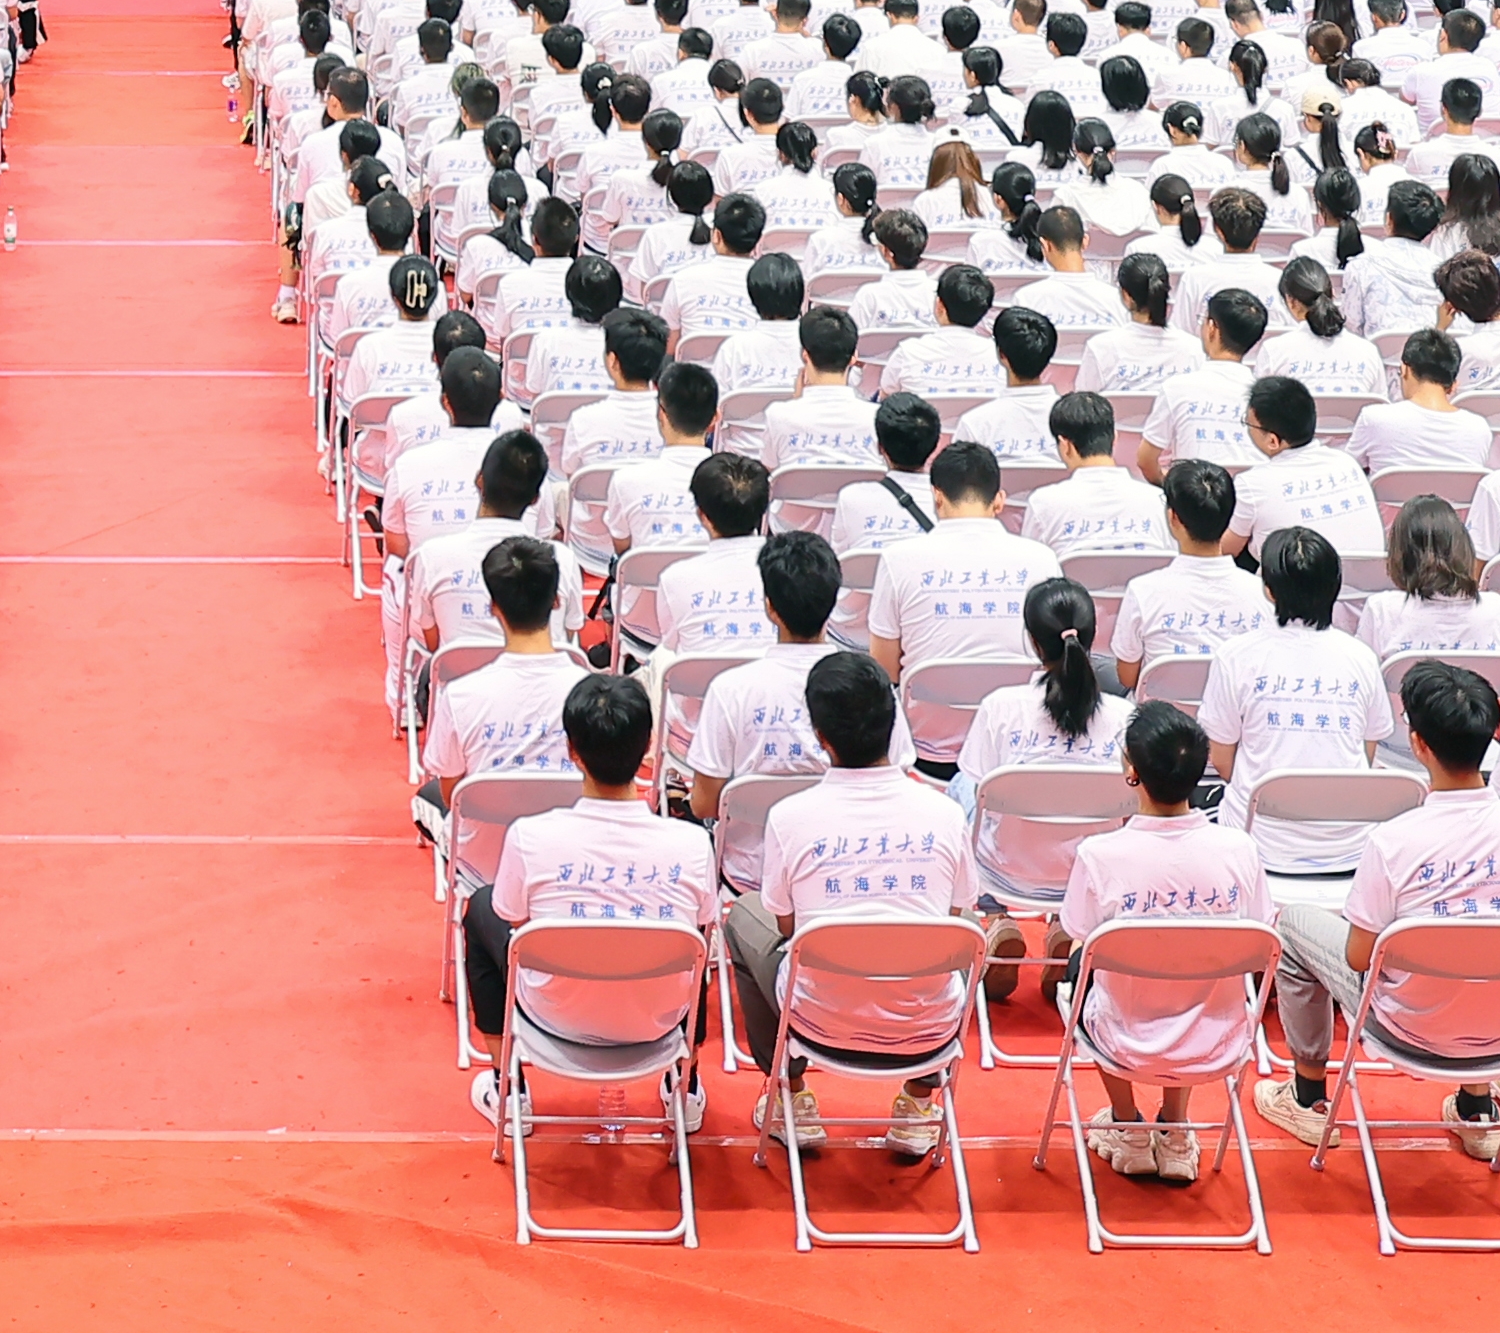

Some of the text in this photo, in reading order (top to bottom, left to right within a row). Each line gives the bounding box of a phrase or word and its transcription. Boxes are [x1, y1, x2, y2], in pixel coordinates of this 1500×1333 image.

[934, 601, 1020, 617] 航海学院
[1266, 711, 1351, 730] 航海学院
[825, 874, 927, 893] 航海学院
[570, 901, 675, 919] 航海学院
